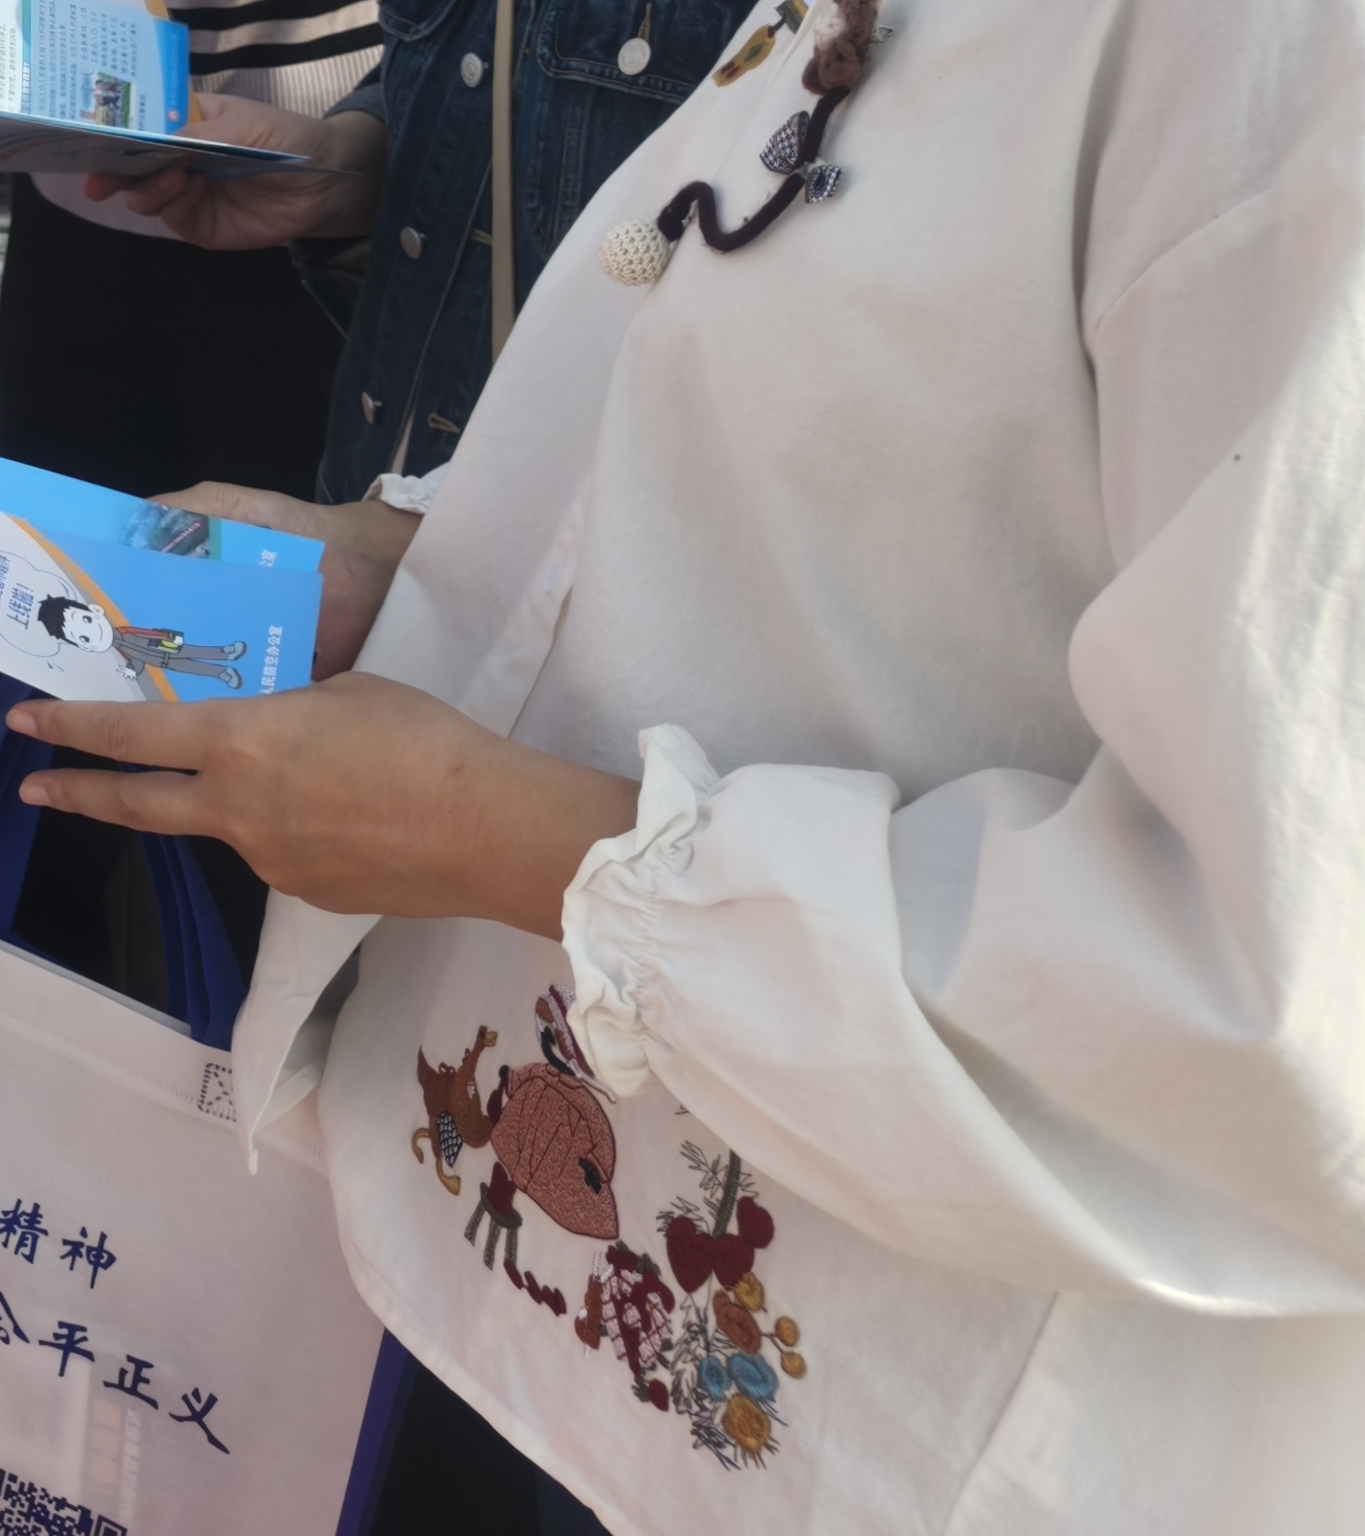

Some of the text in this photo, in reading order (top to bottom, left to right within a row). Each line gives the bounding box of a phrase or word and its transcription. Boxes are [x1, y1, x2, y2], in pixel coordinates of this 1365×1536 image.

[260, 625, 284, 695] 人民防空办公室
